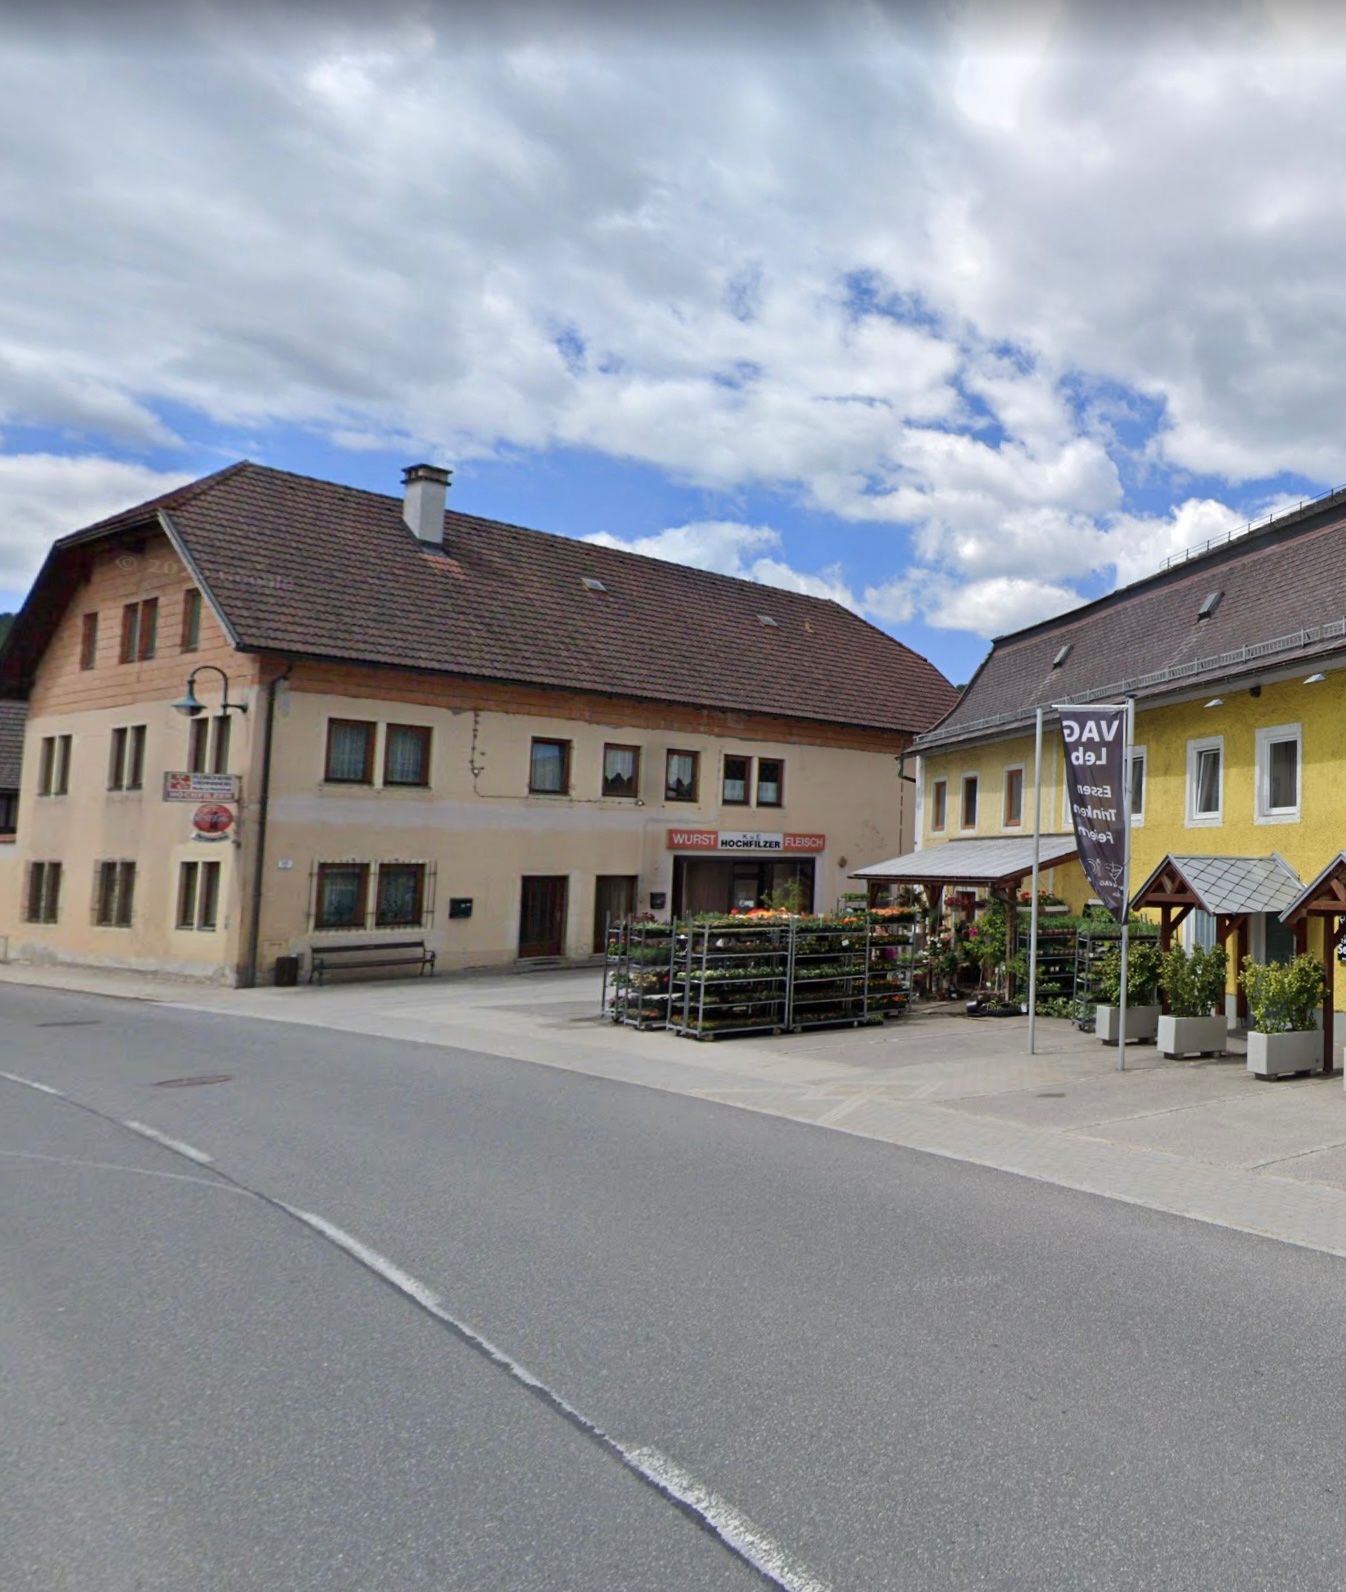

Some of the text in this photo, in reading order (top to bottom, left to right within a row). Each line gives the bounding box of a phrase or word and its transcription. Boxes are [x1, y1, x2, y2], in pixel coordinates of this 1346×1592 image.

[672, 833, 716, 845] WURST
[720, 839, 780, 849] HOCHFILZER
[784, 836, 824, 848] FLEISCH
